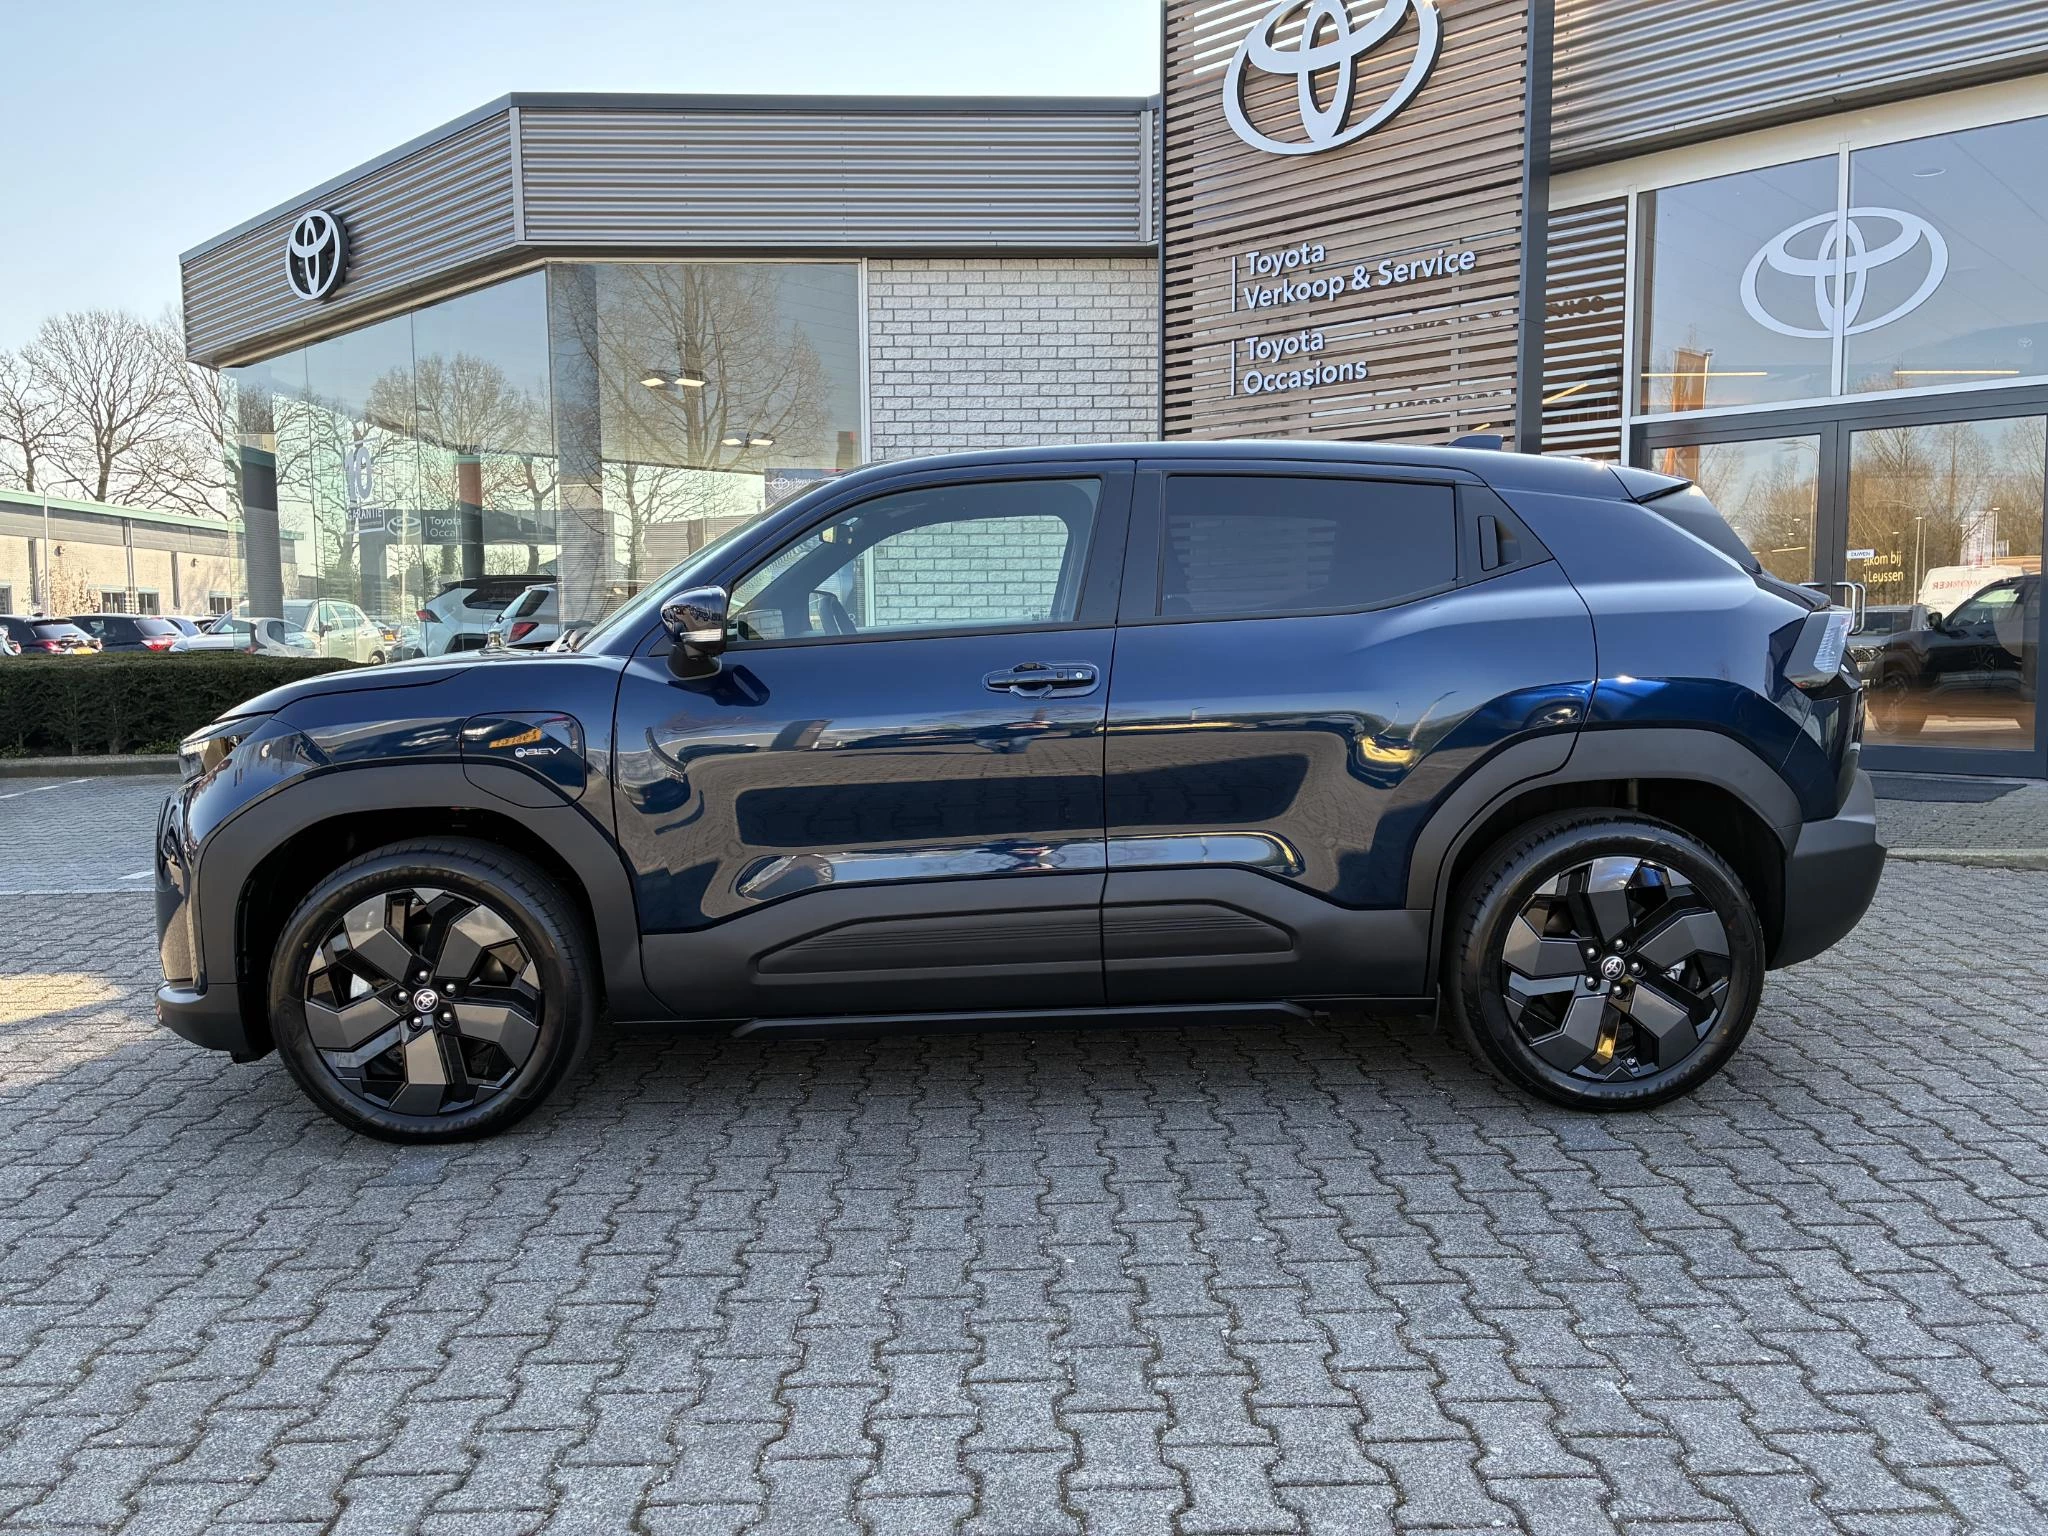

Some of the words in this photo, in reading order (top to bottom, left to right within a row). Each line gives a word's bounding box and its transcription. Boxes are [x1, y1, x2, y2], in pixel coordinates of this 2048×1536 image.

[1245, 242, 1326, 278] Toyota
[1243, 273, 1346, 311] Verkoop
[1351, 264, 1372, 291] &
[1377, 248, 1477, 287] Service
[1244, 330, 1325, 363] Toyota
[1243, 360, 1368, 395] Occasions
[345, 446, 373, 501] 10
[347, 508, 382, 521] GARANTIE
[430, 516, 462, 528] Toyota
[1890, 550, 1902, 567] bij
[1868, 571, 1904, 583] Leussen
